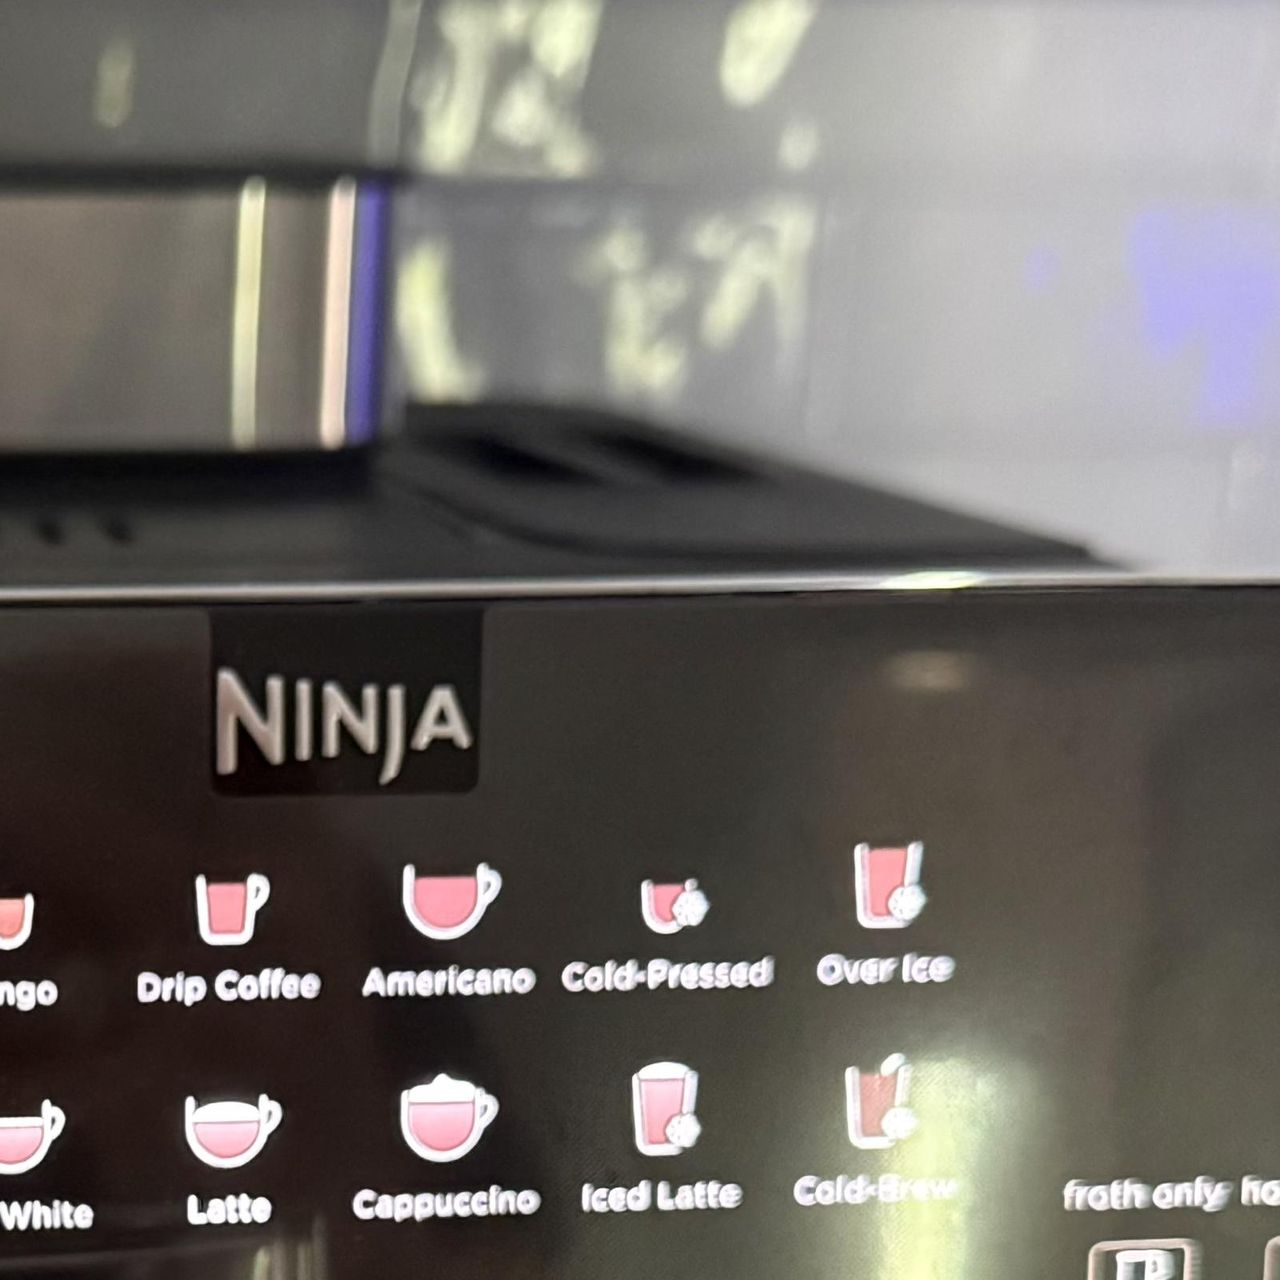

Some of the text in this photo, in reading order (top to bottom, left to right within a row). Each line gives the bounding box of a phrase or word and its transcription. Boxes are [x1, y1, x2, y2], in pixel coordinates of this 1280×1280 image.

[216, 668, 472, 785] NINJA
[137, 967, 322, 1007] Drip Coffee
[361, 964, 537, 997] Americano
[561, 956, 775, 993] Cold-Pressed
[816, 953, 956, 986] Over Ice
[352, 1184, 541, 1223] Cappuccino
[581, 1179, 743, 1213] Iced Latte
[793, 1174, 958, 1206] Cold-Brew
[1062, 1175, 1231, 1213] froth only
[186, 1192, 273, 1226] Latte
